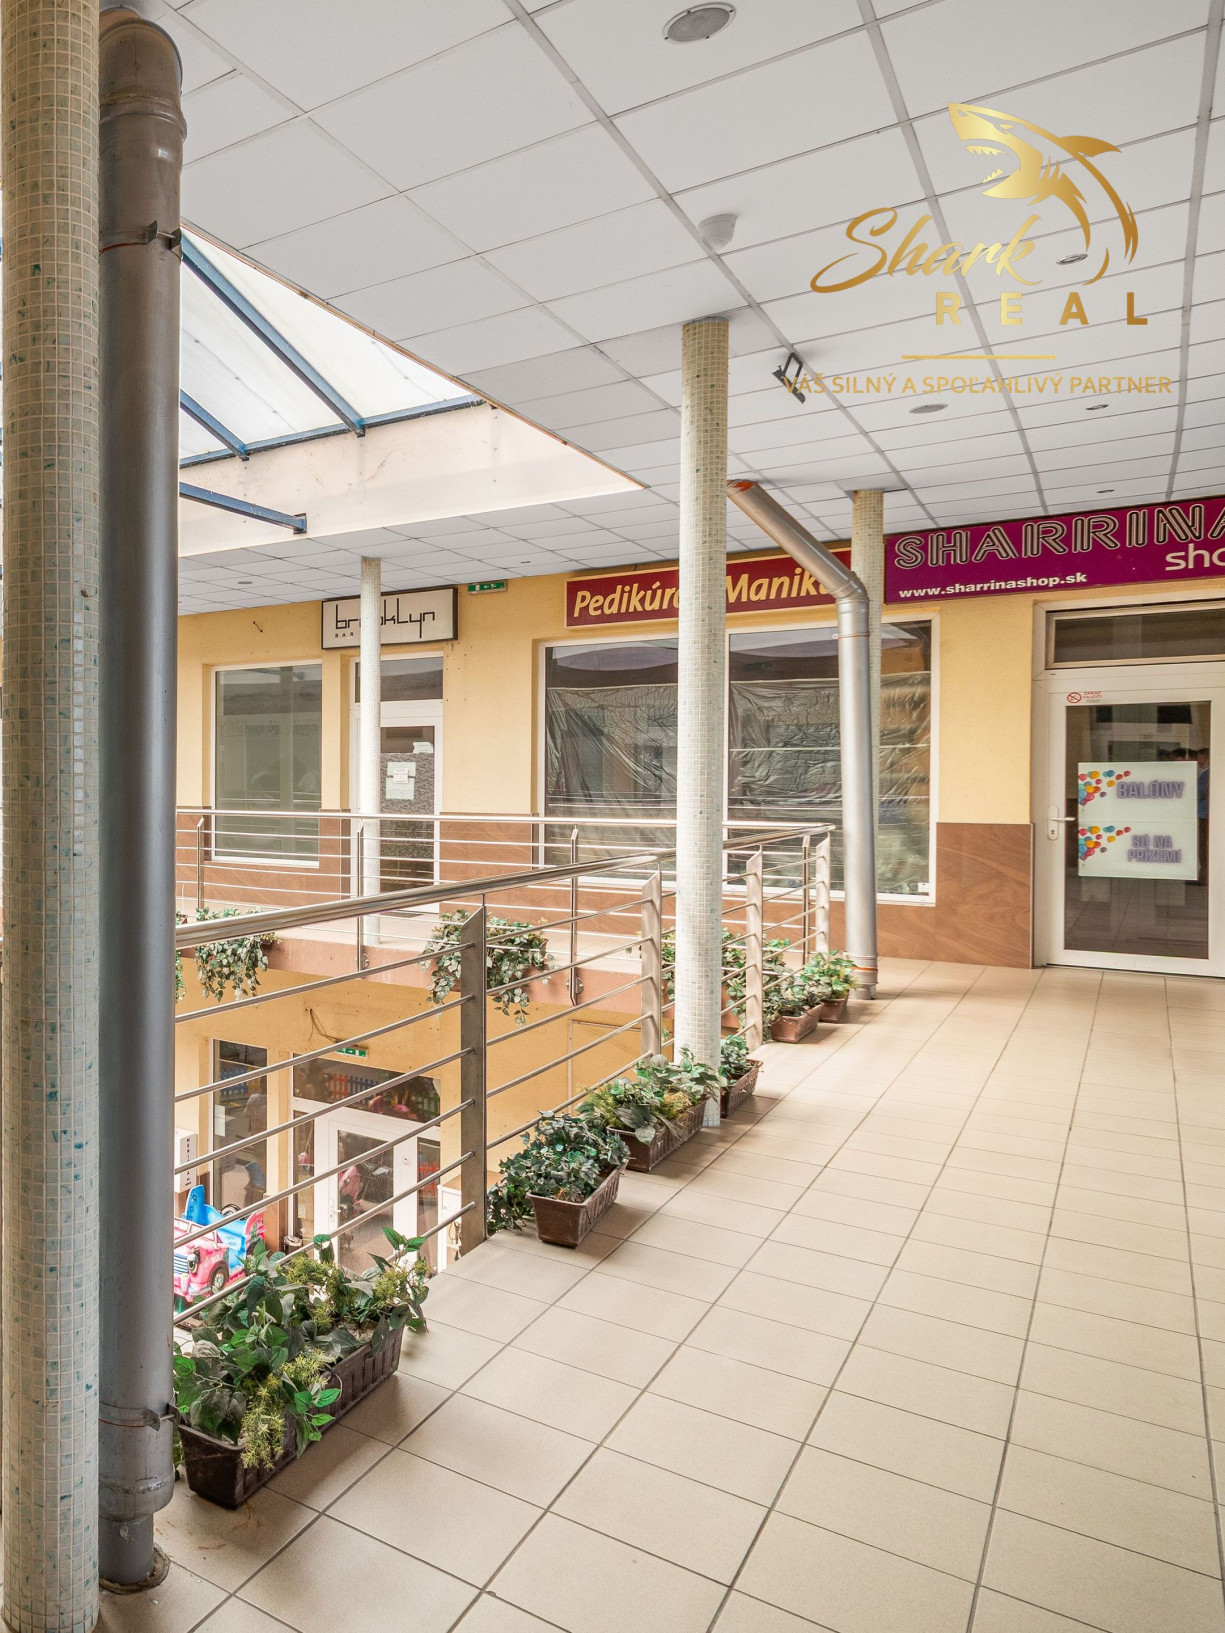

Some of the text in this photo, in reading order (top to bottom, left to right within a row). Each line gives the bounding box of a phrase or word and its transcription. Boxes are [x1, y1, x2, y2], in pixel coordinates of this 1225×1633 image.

[899, 573, 1087, 598] www.sharrinashop.sk
[1117, 779, 1185, 799] BALÓNY
[1131, 834, 1173, 849] SÚ NA
